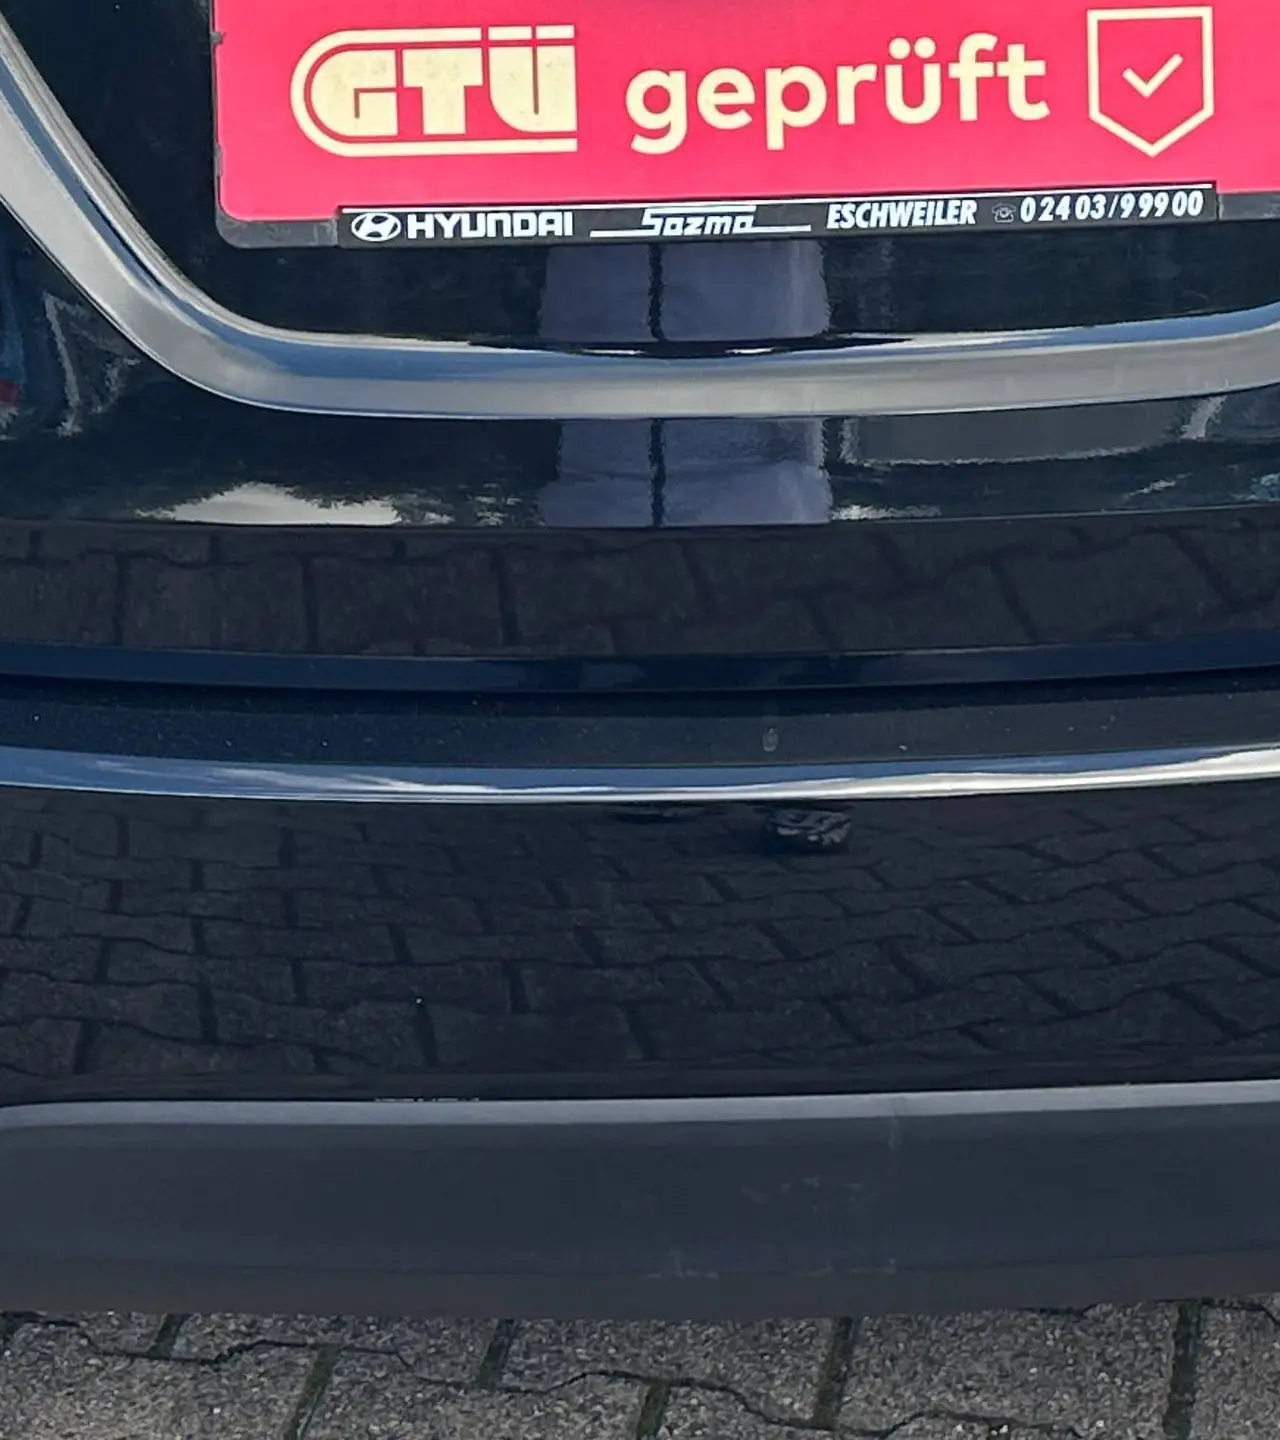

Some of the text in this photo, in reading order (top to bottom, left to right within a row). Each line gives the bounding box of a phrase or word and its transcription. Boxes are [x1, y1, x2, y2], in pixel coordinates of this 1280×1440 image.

[291, 25, 1051, 157] GTÜ geprüft
[406, 212, 574, 239] HYUNDAI
[827, 200, 977, 230] ESCHWEILER
